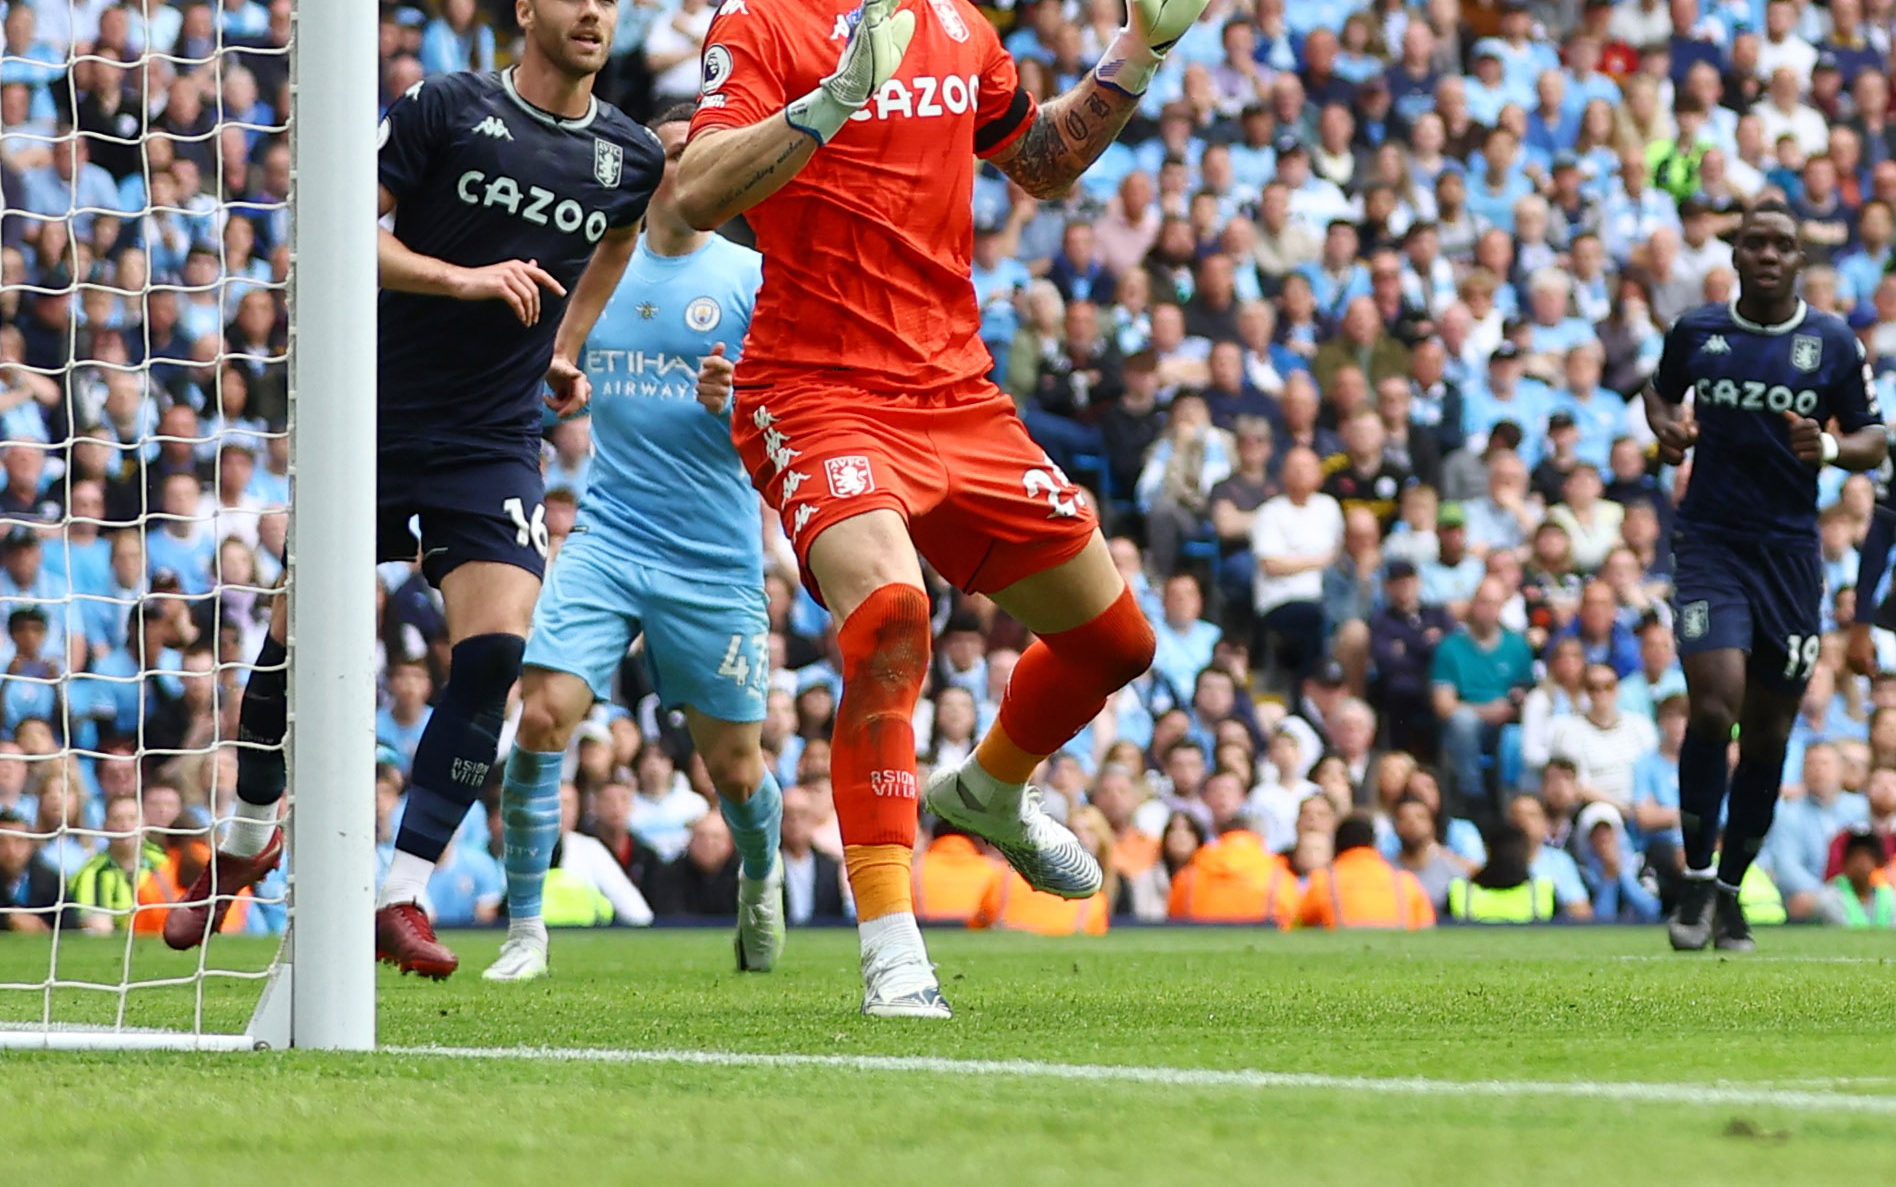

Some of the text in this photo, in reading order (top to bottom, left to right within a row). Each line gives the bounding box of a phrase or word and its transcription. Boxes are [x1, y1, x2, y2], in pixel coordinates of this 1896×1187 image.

[456, 170, 609, 244] CAZOO
[587, 349, 706, 379] ETIHA
[1696, 378, 1819, 415] CAZOO
[503, 498, 549, 559] 16
[1784, 634, 1820, 680] 19
